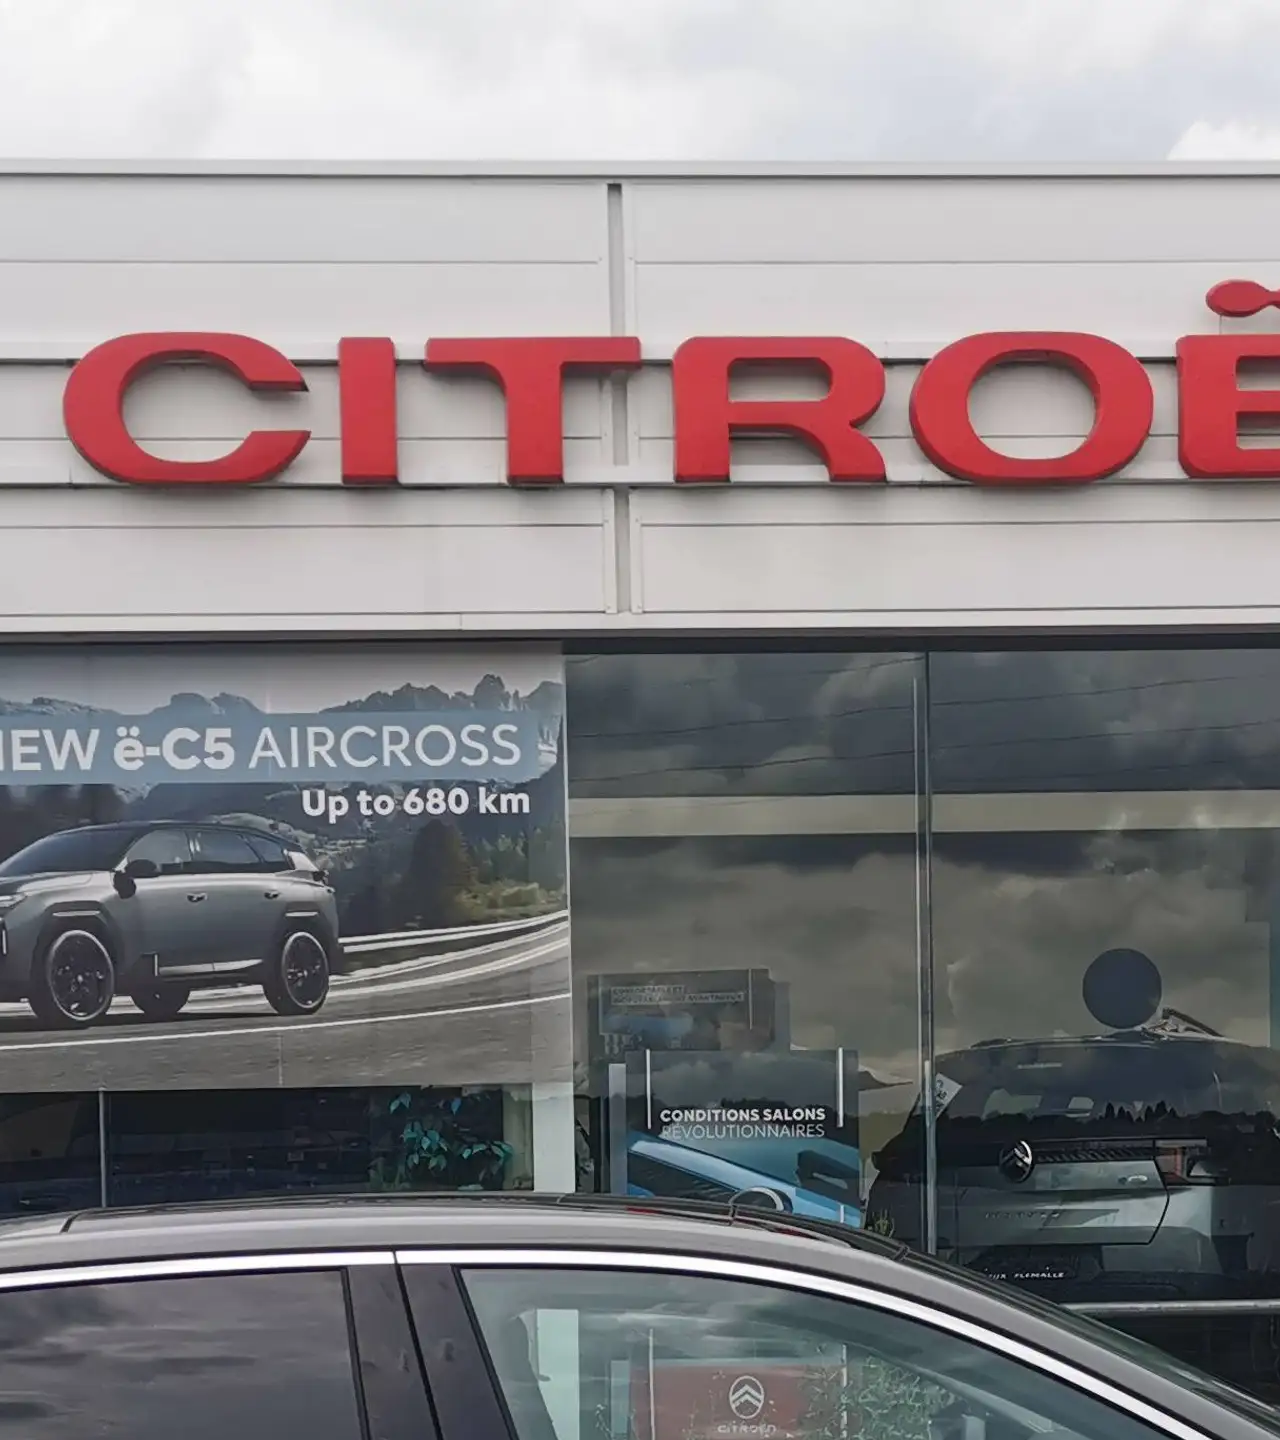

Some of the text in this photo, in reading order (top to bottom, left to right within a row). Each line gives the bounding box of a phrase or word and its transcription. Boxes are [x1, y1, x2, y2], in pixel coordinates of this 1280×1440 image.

[113, 726, 236, 772] ë-C5
[248, 724, 522, 769] AIRCROSS
[302, 787, 531, 824] Up to 680 km
[659, 1108, 826, 1123] CONDITIONS SALONS
[661, 1123, 825, 1139] RÉVOLUTIONNAIRES
